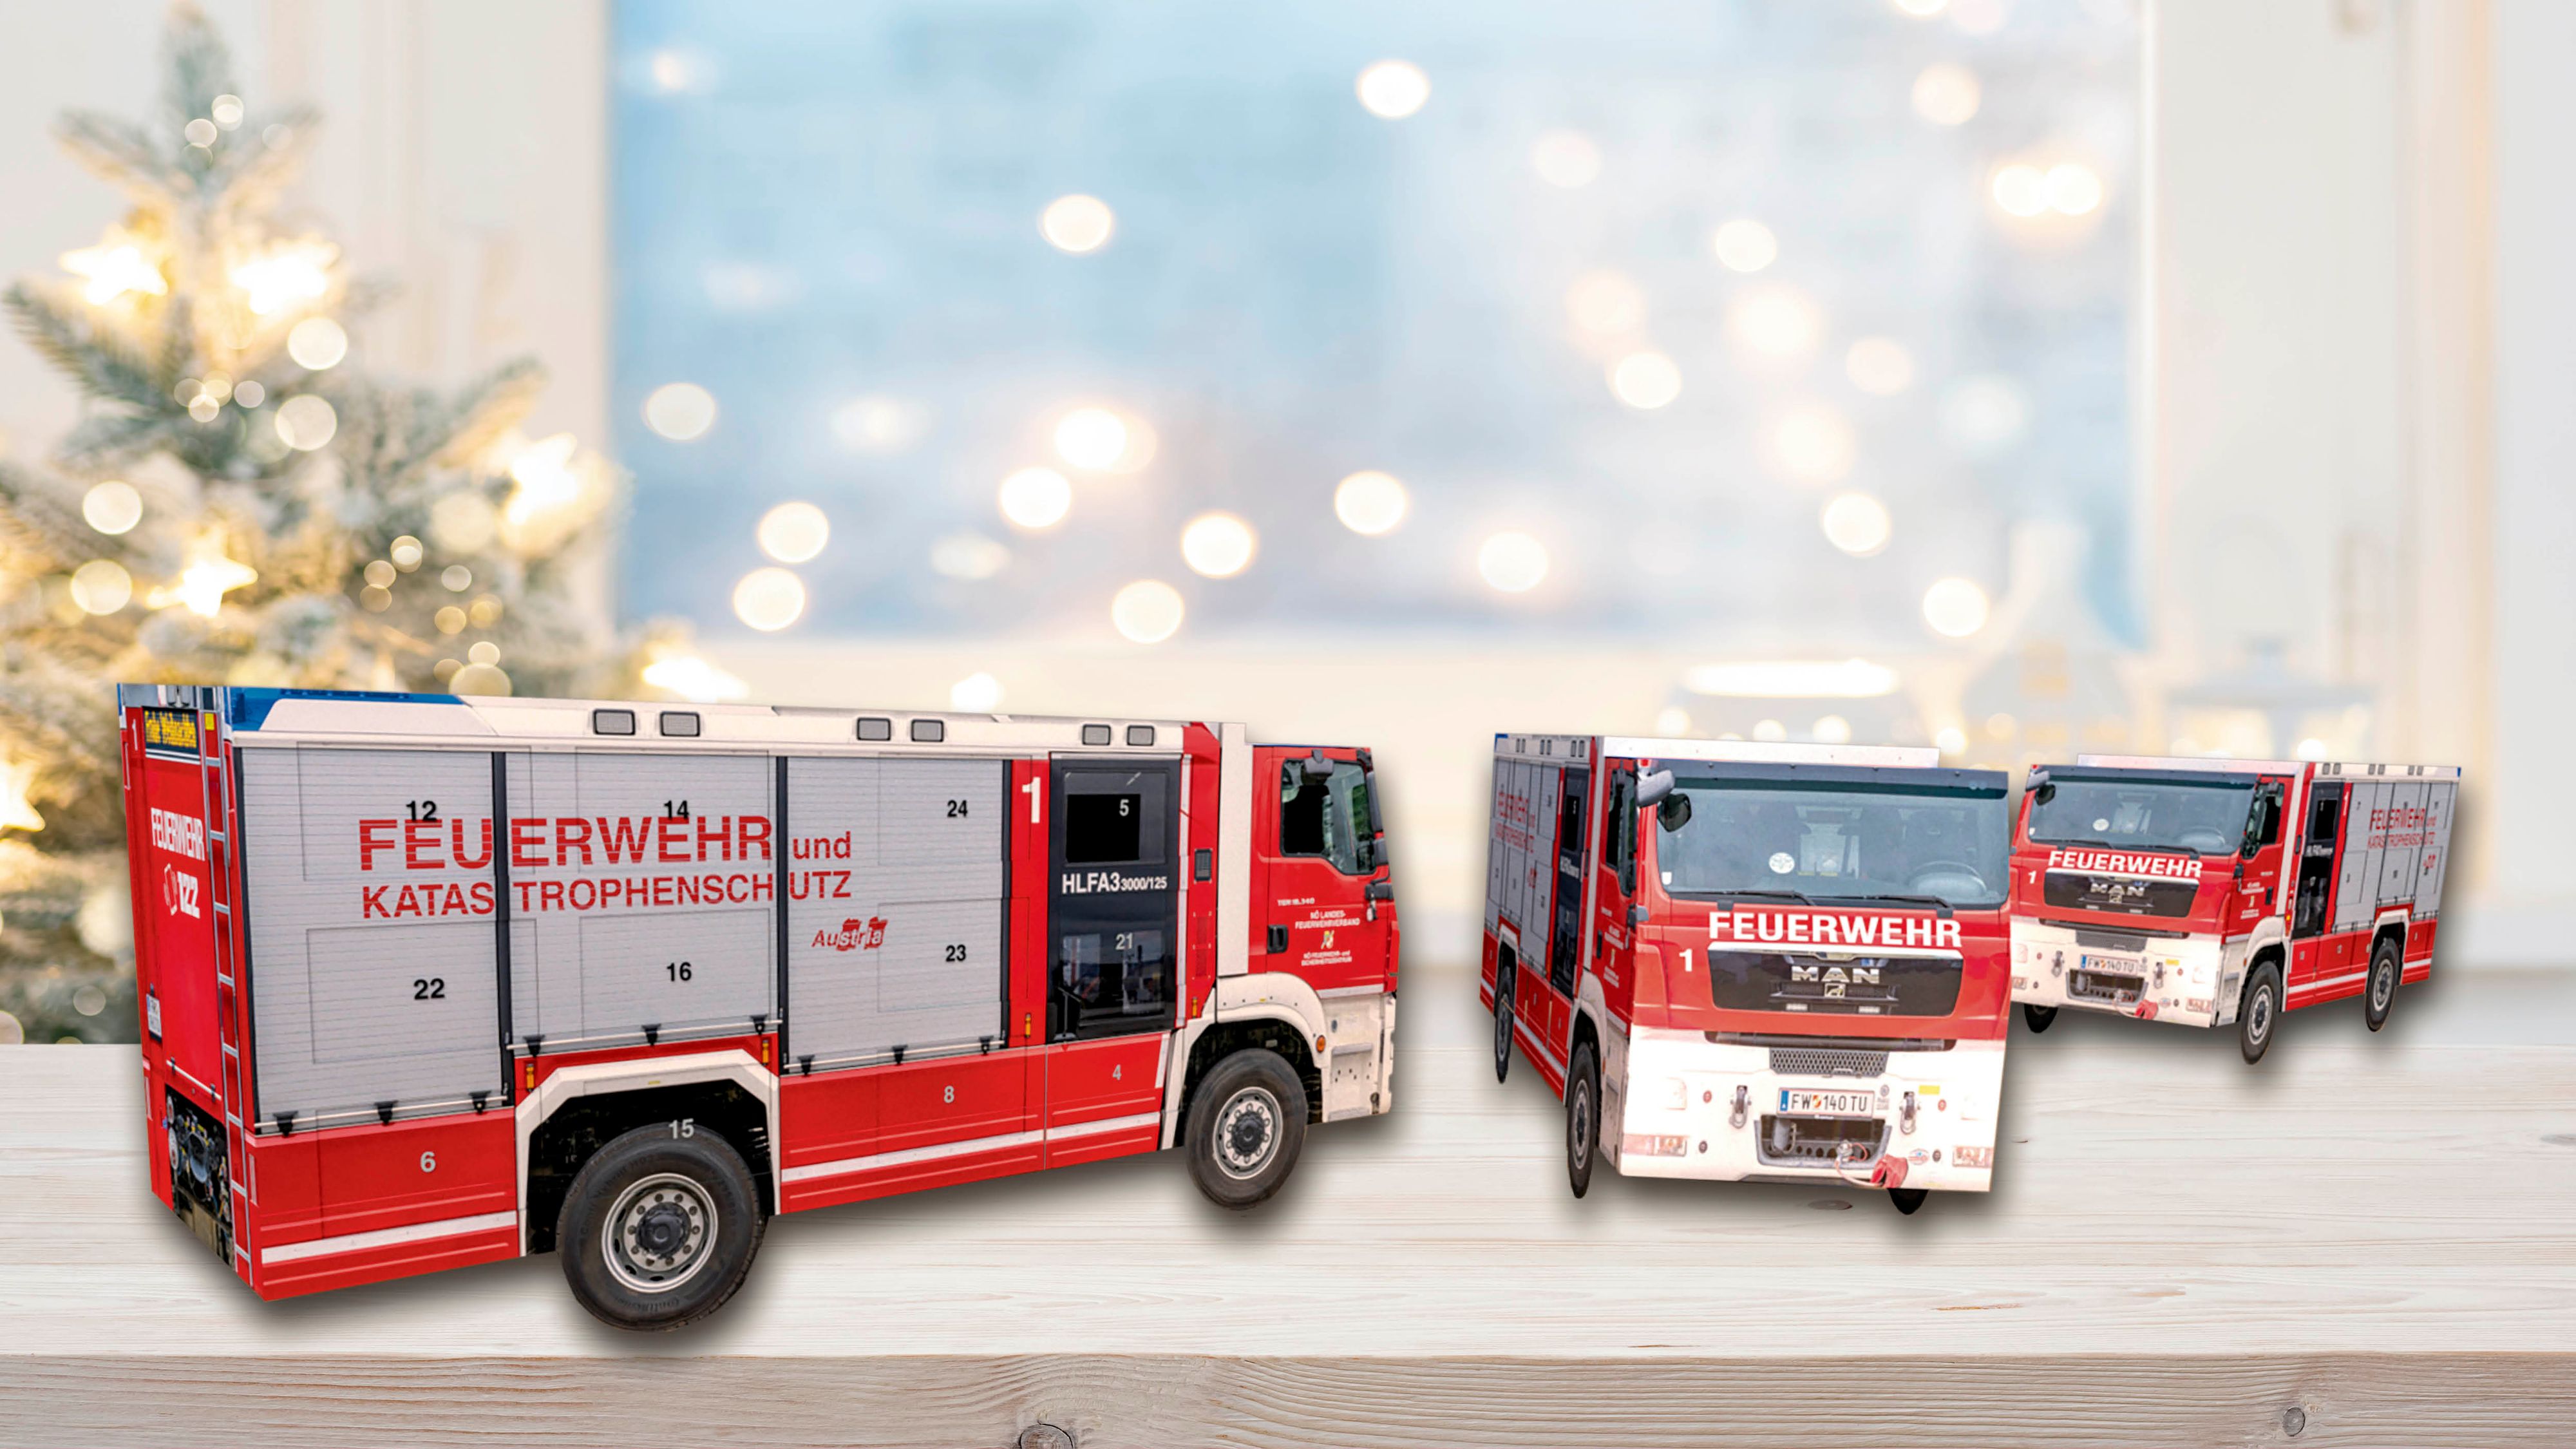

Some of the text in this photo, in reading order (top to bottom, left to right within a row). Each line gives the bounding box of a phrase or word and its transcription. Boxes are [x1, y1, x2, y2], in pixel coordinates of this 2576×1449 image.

[131, 719, 138, 751] 1
[406, 800, 437, 822] 12
[663, 799, 690, 820] 14
[947, 800, 969, 819] 24
[1022, 777, 1041, 824] 1
[1119, 799, 1130, 817] 5
[151, 807, 205, 862] FEUERWEHR
[792, 830, 851, 860] und
[2048, 850, 2203, 878] FEUERWEHR
[1062, 872, 1168, 894] HLFA3 3000/125
[2028, 871, 2037, 884] 1
[177, 871, 201, 920] 122
[2090, 882, 2145, 898] MAN
[811, 916, 889, 951] Austria
[1709, 911, 1962, 947] FEUERWEHR
[1115, 932, 1133, 950] 21
[945, 944, 967, 962] 23
[1678, 948, 1693, 972] 1
[666, 961, 692, 982] 16
[1790, 966, 1880, 984] MAN
[413, 978, 446, 1000] 22
[1112, 1064, 1122, 1081] 4
[943, 1085, 954, 1104] 8
[1791, 1093, 1812, 1110] FW
[1823, 1094, 1847, 1111] 140
[1850, 1096, 1868, 1112] TU
[668, 1118, 694, 1139] 15
[419, 1150, 436, 1173] 6
